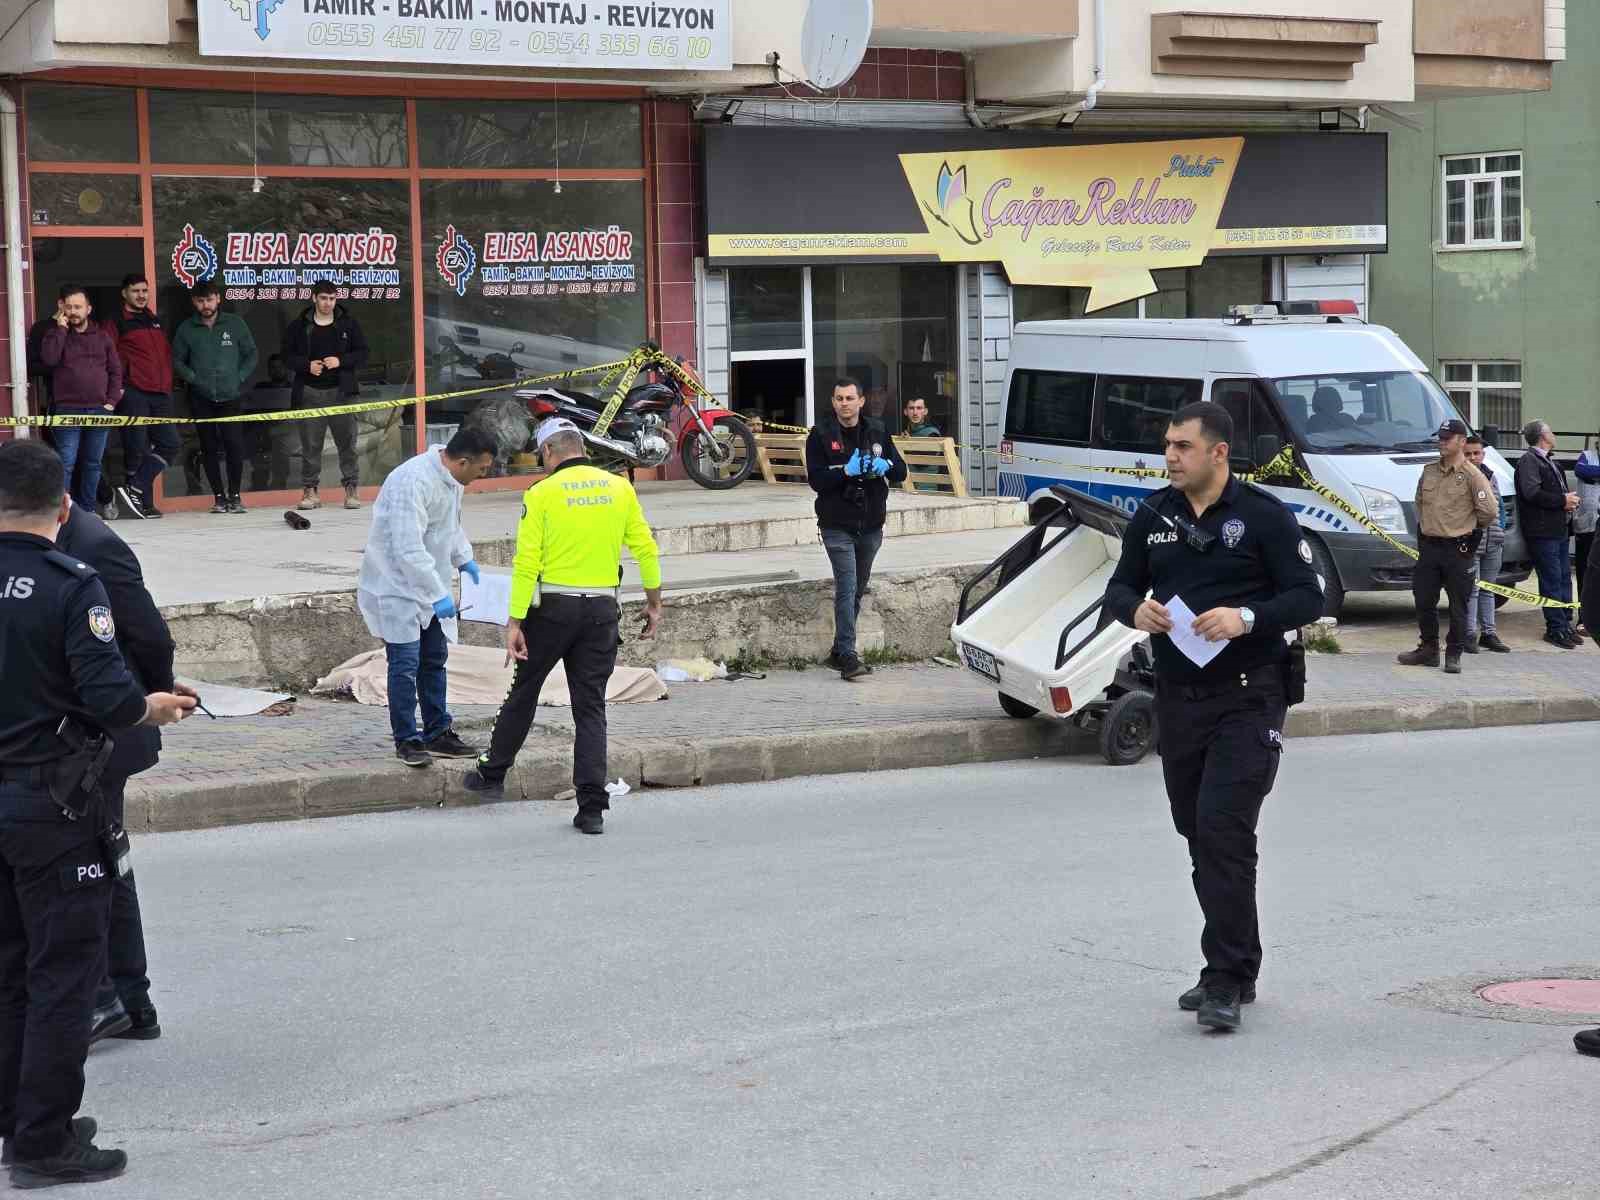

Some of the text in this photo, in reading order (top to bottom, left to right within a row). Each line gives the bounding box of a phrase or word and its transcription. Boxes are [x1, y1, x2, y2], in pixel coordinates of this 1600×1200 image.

[398, 0, 473, 20] BAKIM
[496, 0, 586, 25] MONTAJ
[607, 2, 714, 29] REVİZYON
[307, 21, 376, 47] 0553
[383, 25, 426, 49] 451
[433, 27, 464, 50] 77
[470, 28, 502, 52] 92
[528, 31, 589, 55] 0354
[596, 33, 640, 56] 333
[648, 35, 678, 57] 66
[687, 36, 712, 59] 10
[982, 177, 1198, 241] Çağan Reklam
[293, 227, 399, 265] ASANSÖR
[542, 225, 632, 262] ASANSÖR
[729, 237, 907, 250] www.caganreklam.com
[224, 266, 256, 285] TAMİR
[263, 268, 297, 285] BAKIM
[350, 265, 400, 285] REVİZYON
[481, 264, 509, 282] TAMİR
[516, 266, 545, 281] BAKIM
[550, 265, 586, 281] MONTAJ
[592, 262, 634, 280] REVİZYON
